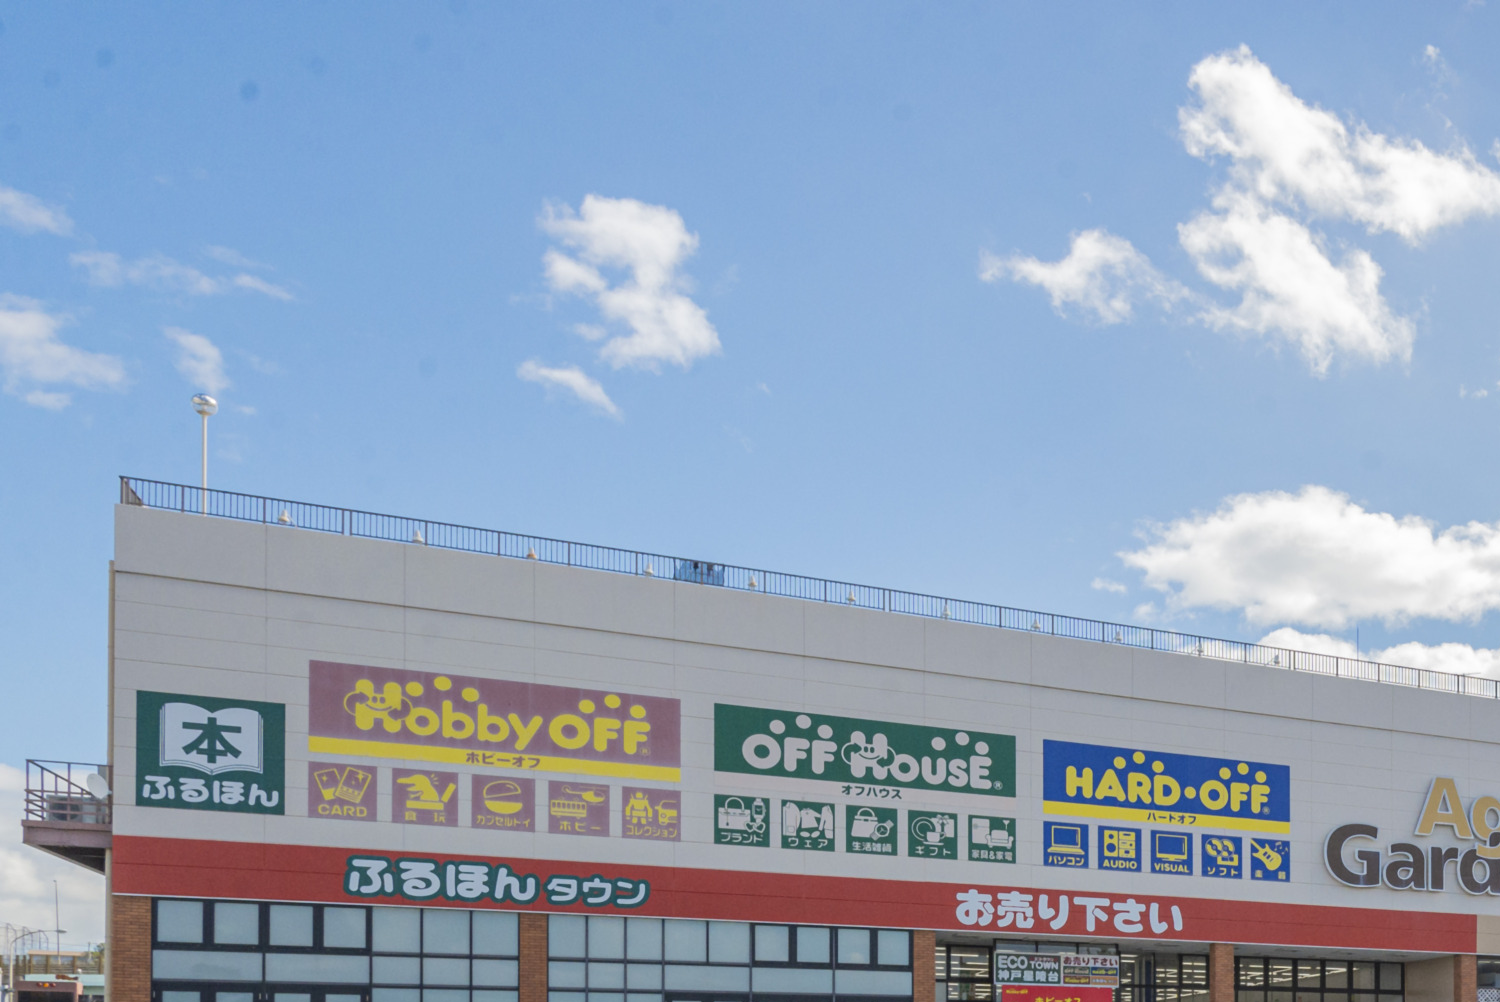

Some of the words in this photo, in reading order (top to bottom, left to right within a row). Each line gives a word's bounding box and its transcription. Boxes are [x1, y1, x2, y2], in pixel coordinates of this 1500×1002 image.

[350, 679, 543, 750] Hobby
[549, 714, 650, 754] OFF
[182, 717, 242, 763] 本
[466, 752, 540, 768] ホビーオフ
[742, 734, 837, 774] OFF
[142, 775, 279, 807] ふるほん
[842, 785, 902, 799] オフハウス
[318, 804, 367, 817] CARD
[477, 815, 530, 827] カプセルトイ
[1147, 812, 1197, 824] ハートオフ
[560, 821, 600, 832] ホビー
[625, 825, 677, 837] コレクション
[721, 832, 763, 843] ブランド
[788, 837, 828, 848] ウェア
[852, 841, 892, 852] 生活雑貨
[915, 846, 951, 856] ギフト
[1048, 856, 1085, 866] パソコン
[1103, 859, 1137, 869] AUDIO
[1154, 863, 1190, 873] VISUAL
[1207, 867, 1238, 876] ソフト
[349, 859, 535, 900] ふるほん
[548, 877, 646, 905] タウン
[956, 889, 1183, 934] お売り下さい
[998, 956, 1028, 969] ECO
[1029, 961, 1059, 970] TOWN
[1063, 956, 1118, 967] お売り下さい
